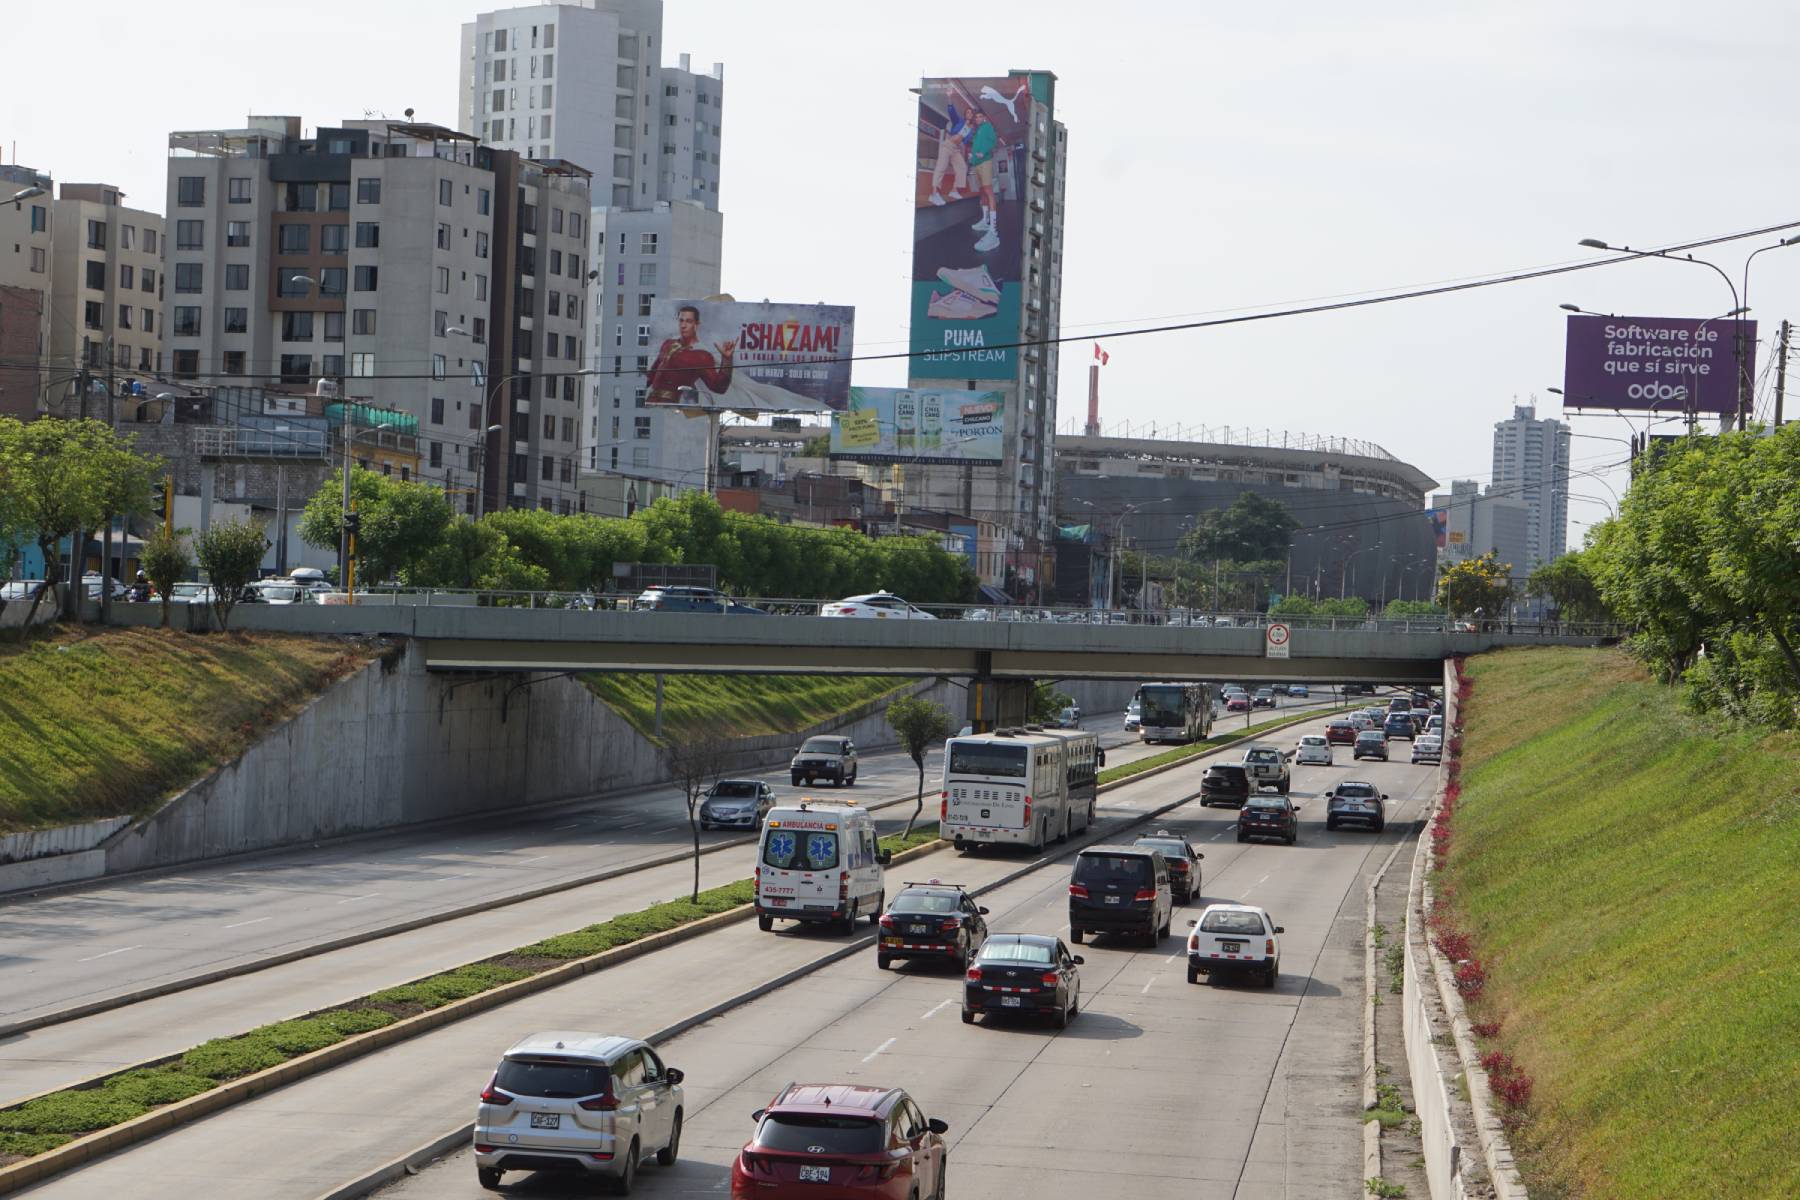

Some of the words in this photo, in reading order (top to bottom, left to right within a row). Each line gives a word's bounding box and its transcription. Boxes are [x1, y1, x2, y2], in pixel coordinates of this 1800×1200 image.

[739, 320, 841, 353] ¡SHAZAM!
[944, 329, 985, 347] PUMA
[1604, 325, 1689, 340] Software
[1695, 327, 1719, 342] de
[923, 348, 1006, 362] SLIPSTREAM
[1607, 341, 1713, 358] fabricación
[1604, 361, 1640, 375] que
[1645, 359, 1662, 373] sí
[1665, 360, 1711, 375] sirve
[782, 821, 824, 830] AMBULANCIA
[764, 886, 794, 895] 435-7777
